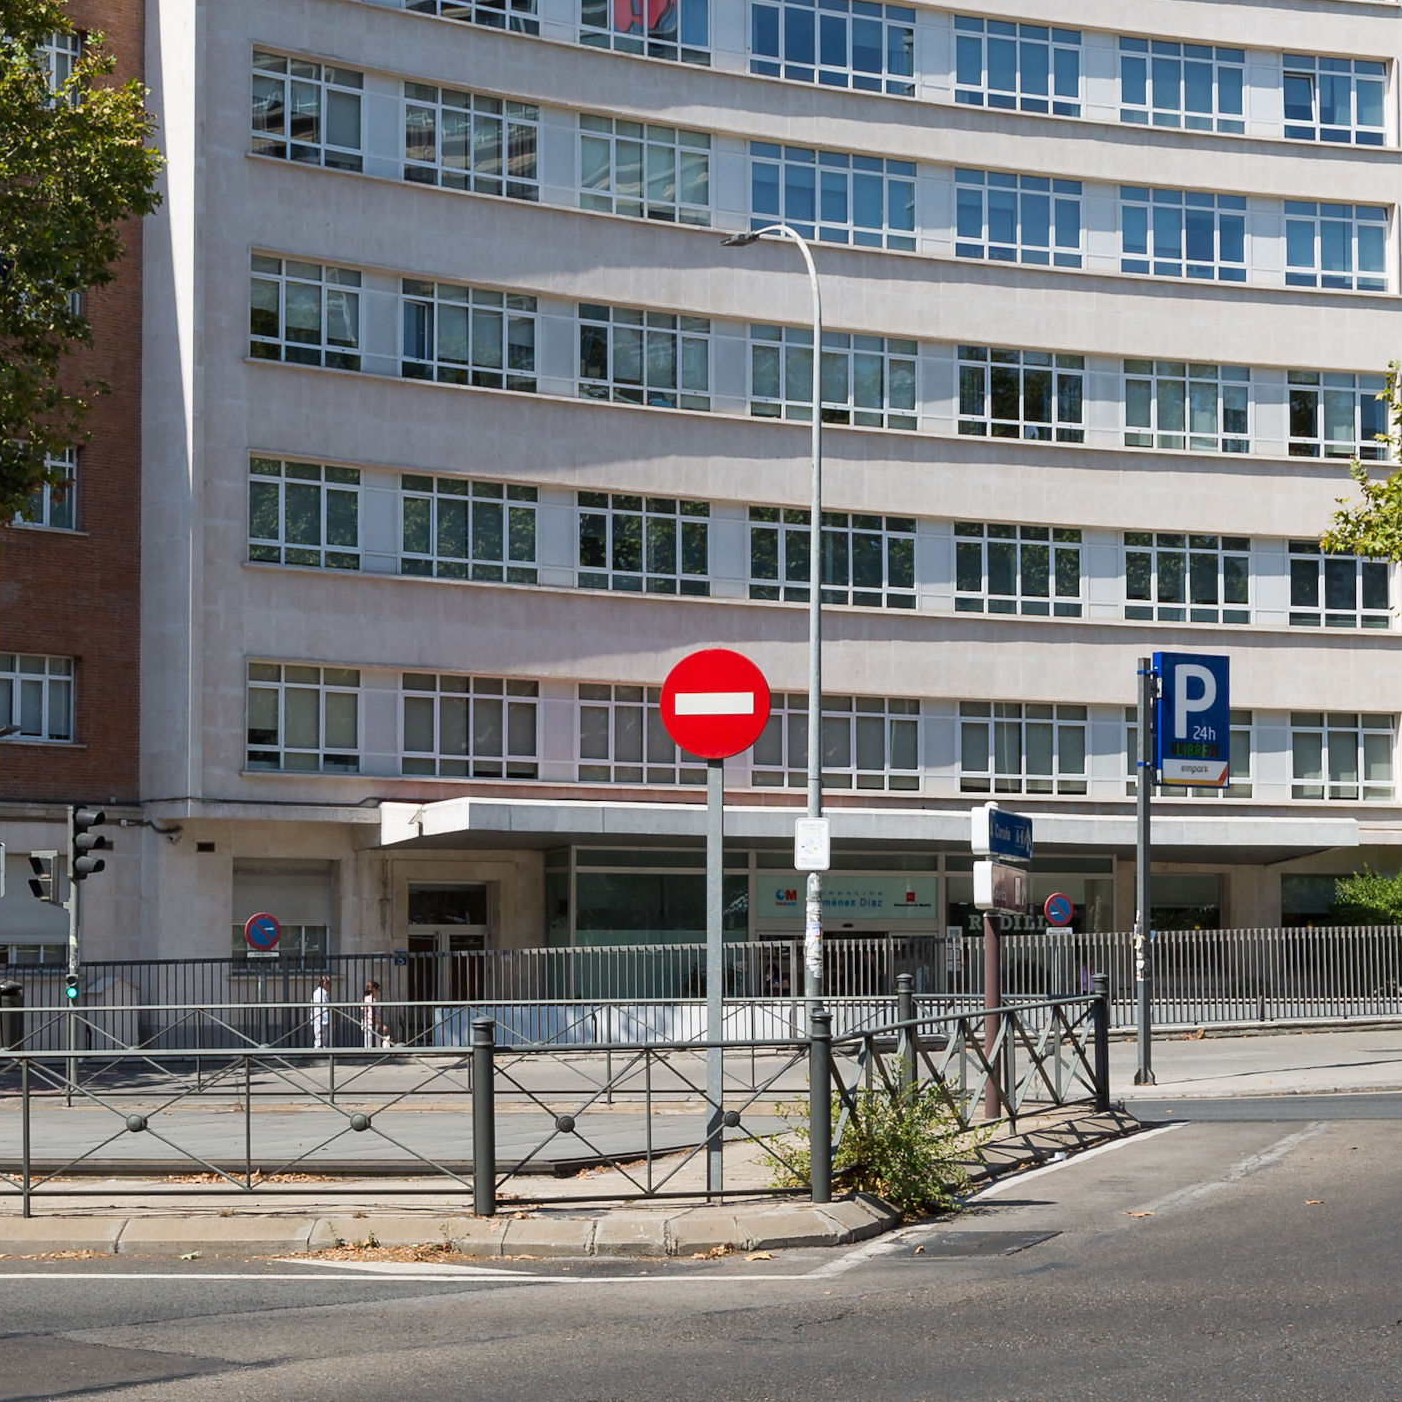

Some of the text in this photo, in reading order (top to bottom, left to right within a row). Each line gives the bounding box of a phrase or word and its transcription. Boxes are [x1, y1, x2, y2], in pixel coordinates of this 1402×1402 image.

[1175, 664, 1217, 739] P
[1192, 725, 1216, 741] 24h
[1176, 744, 1209, 758] LIBRE
[1181, 764, 1209, 775] empark
[821, 894, 883, 908] ménez Díaz
[968, 914, 1049, 931] RDILL
